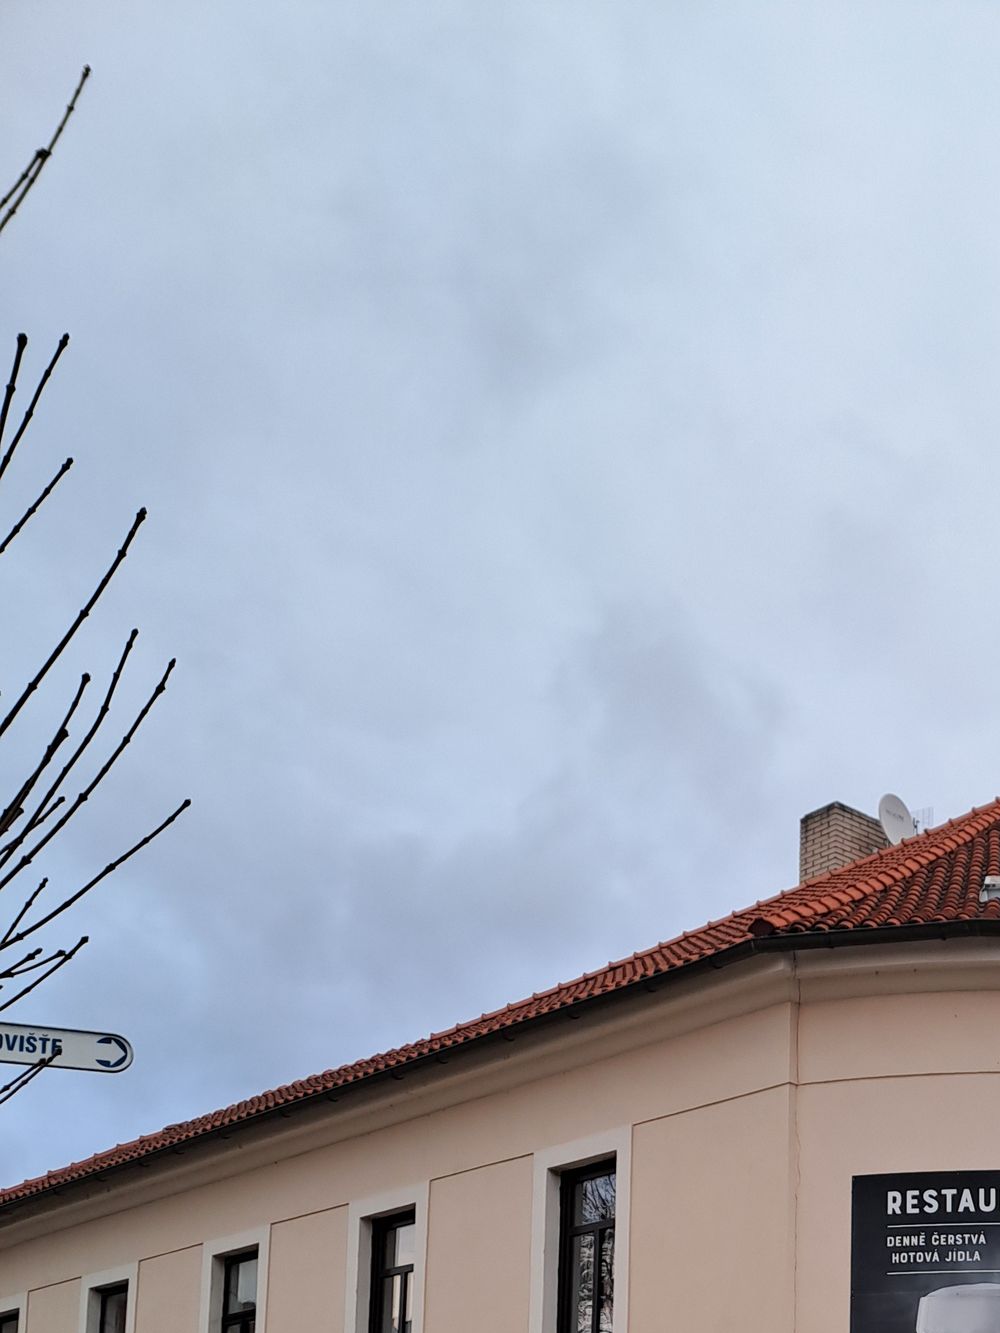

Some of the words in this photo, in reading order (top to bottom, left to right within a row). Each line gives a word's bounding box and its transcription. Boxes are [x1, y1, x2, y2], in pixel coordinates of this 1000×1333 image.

[887, 1232, 926, 1247] DENNĚ
[931, 1231, 987, 1246] ČERSTVÁ
[891, 1248, 940, 1263] HOTOVÁ
[945, 1248, 981, 1262] JÍDLA
